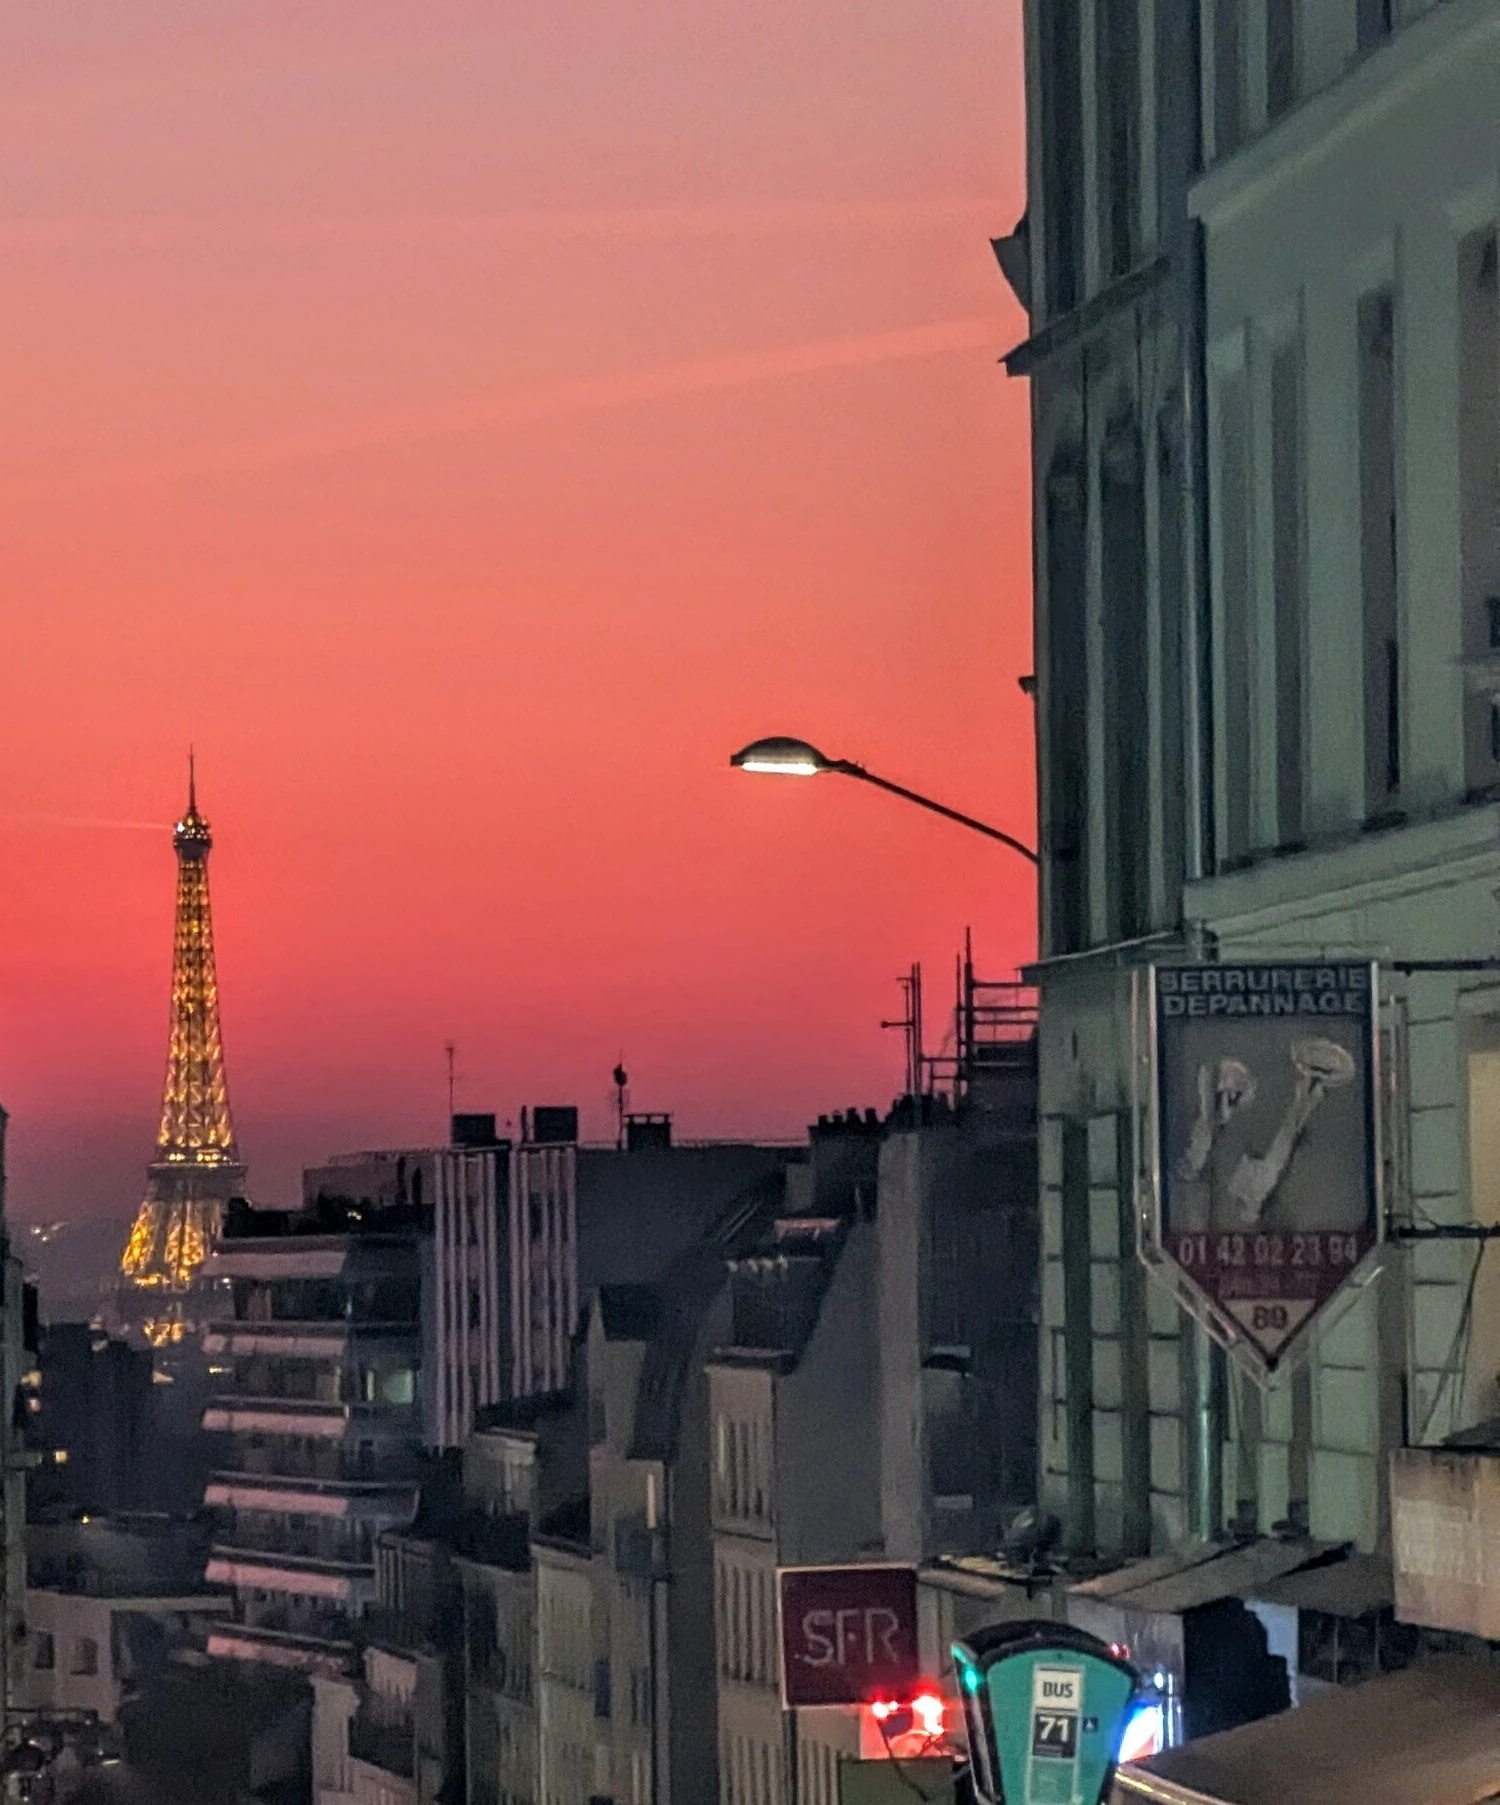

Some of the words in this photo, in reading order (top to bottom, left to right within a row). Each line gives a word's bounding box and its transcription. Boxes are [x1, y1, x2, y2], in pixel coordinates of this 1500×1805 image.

[1159, 968, 1366, 993] SERRURERIE
[1163, 992, 1366, 1016] DEPANNAGE
[1179, 1237, 1207, 1266] 01
[802, 1608, 899, 1667] SFR
[1042, 1681, 1073, 1698] BUS
[1039, 1716, 1070, 1742] 71
